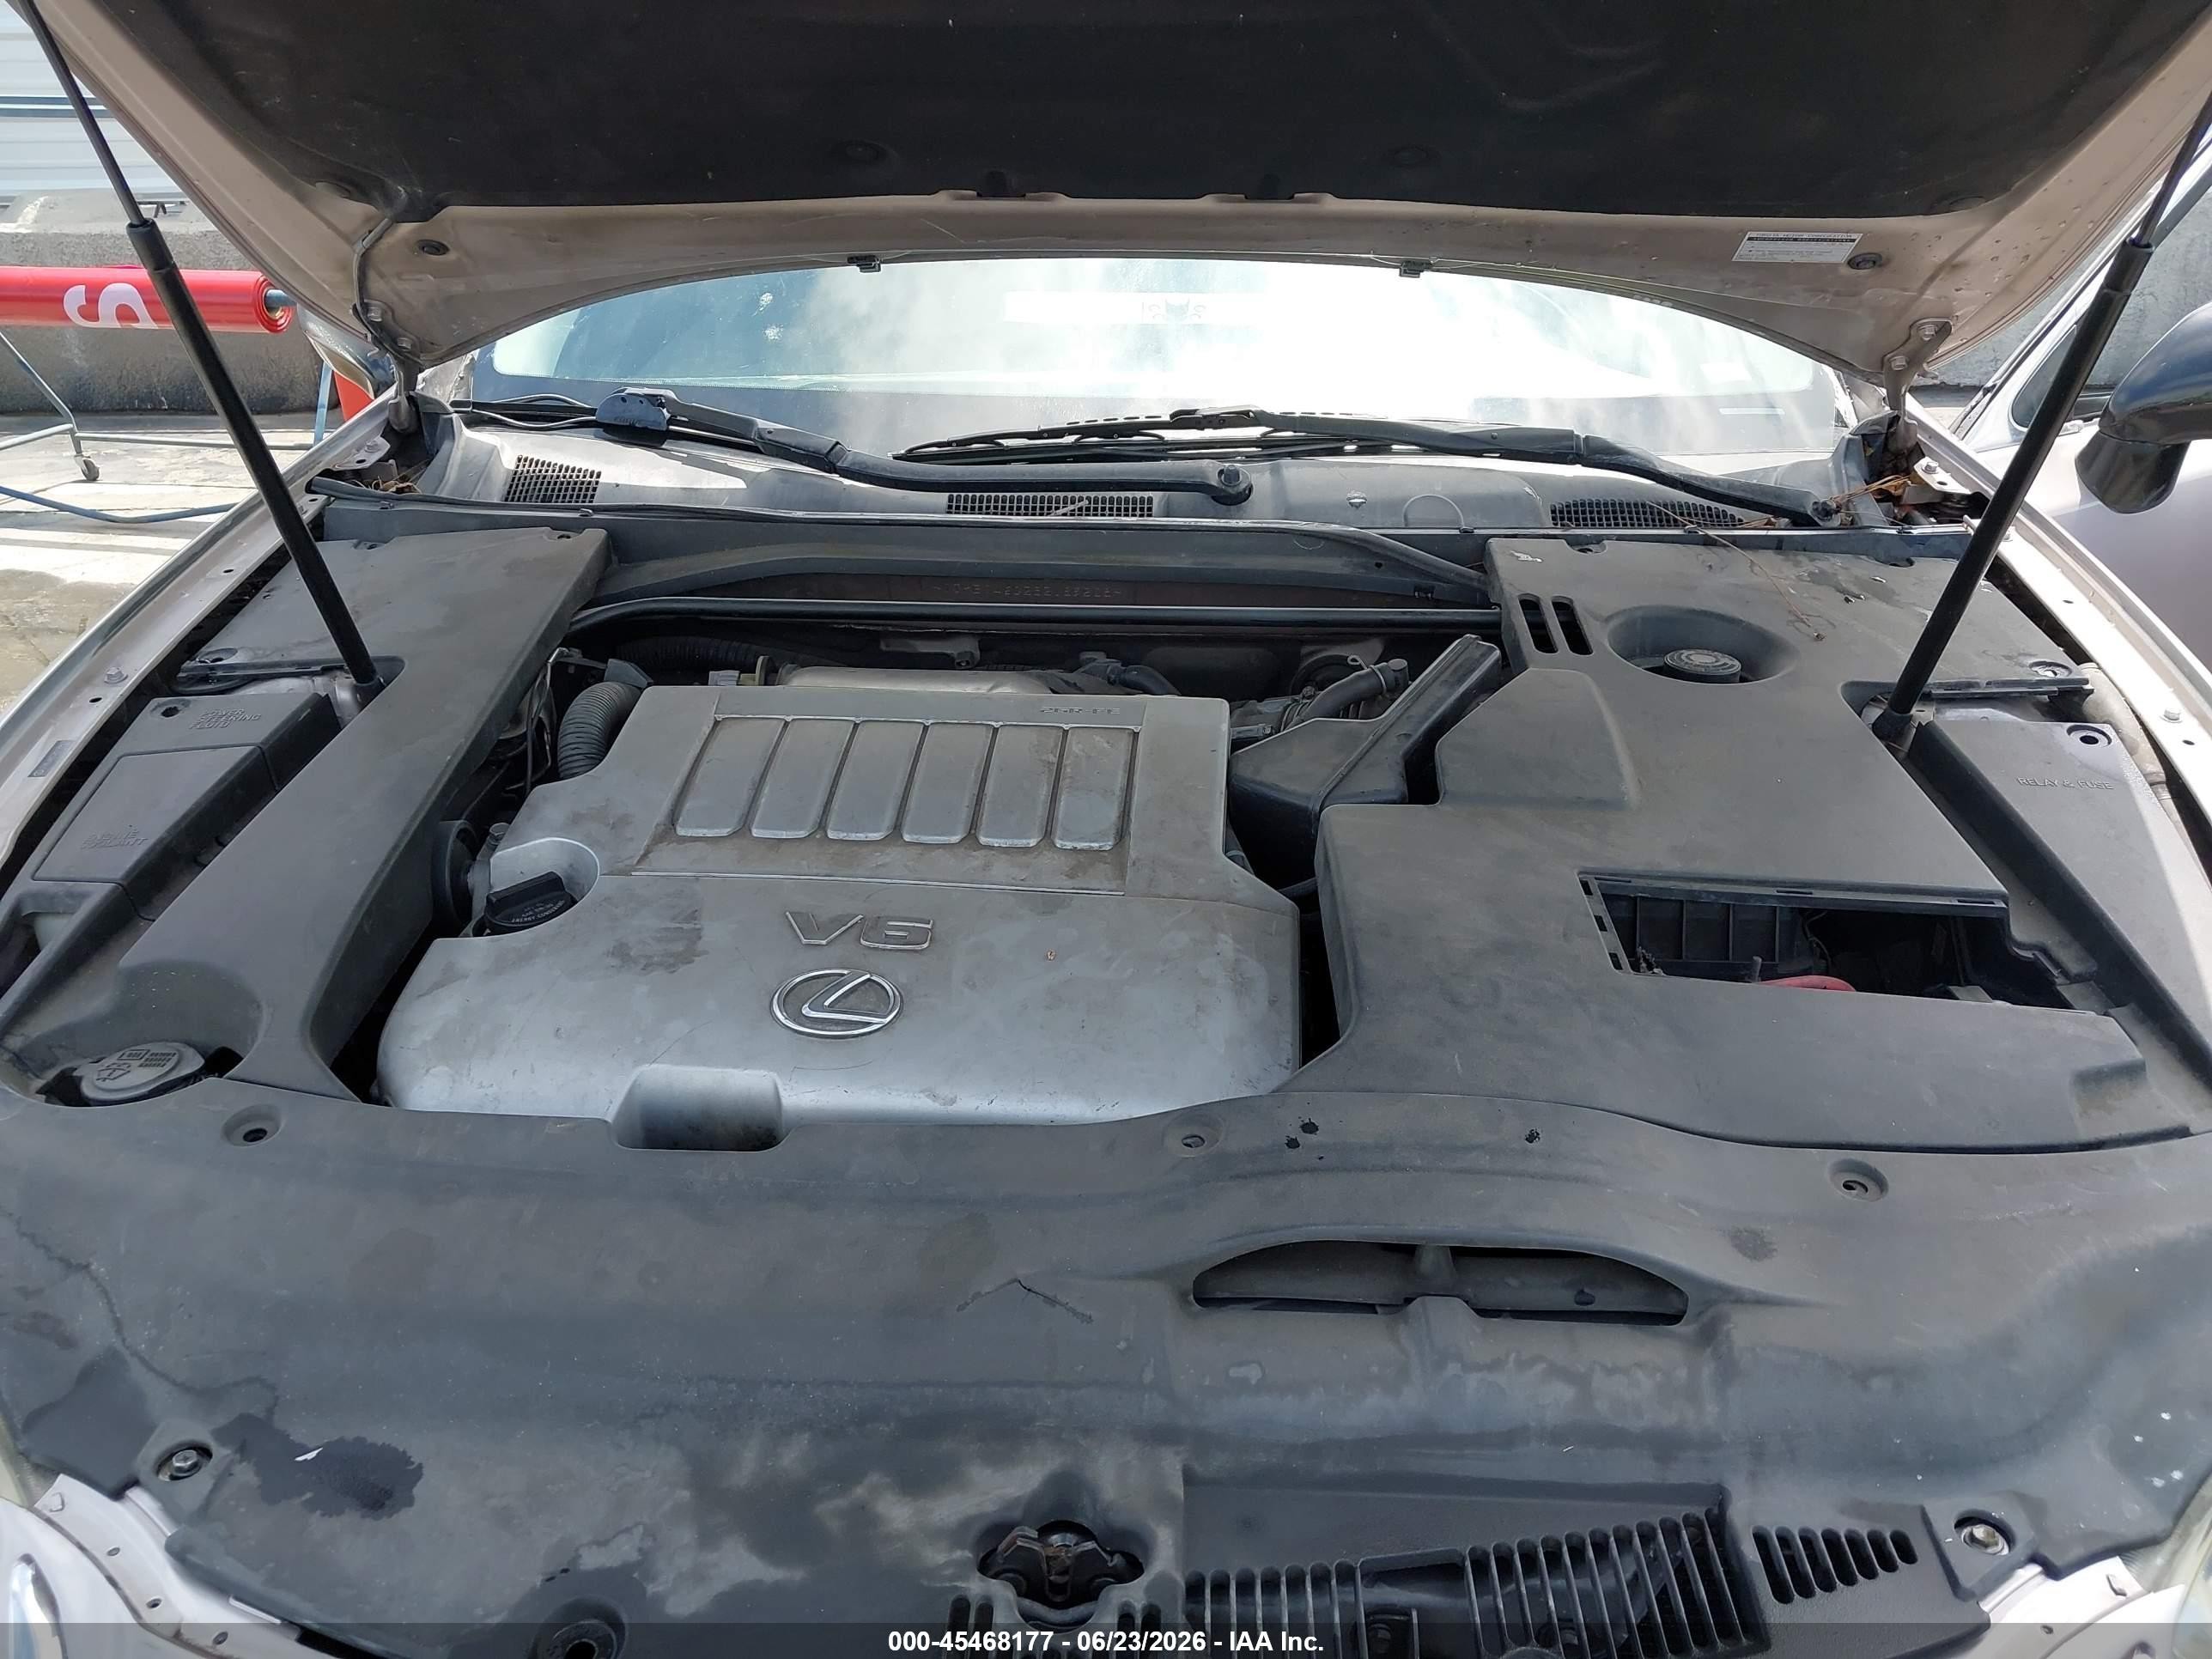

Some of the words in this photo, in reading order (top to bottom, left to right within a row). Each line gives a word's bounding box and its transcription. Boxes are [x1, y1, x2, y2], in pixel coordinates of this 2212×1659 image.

[198, 714, 262, 723] STEERING
[188, 720, 230, 730] FLUID
[2015, 776, 2058, 787] RELAY
[2063, 779, 2075, 788] &
[2077, 780, 2115, 790] FUSE
[785, 911, 934, 950] V6
